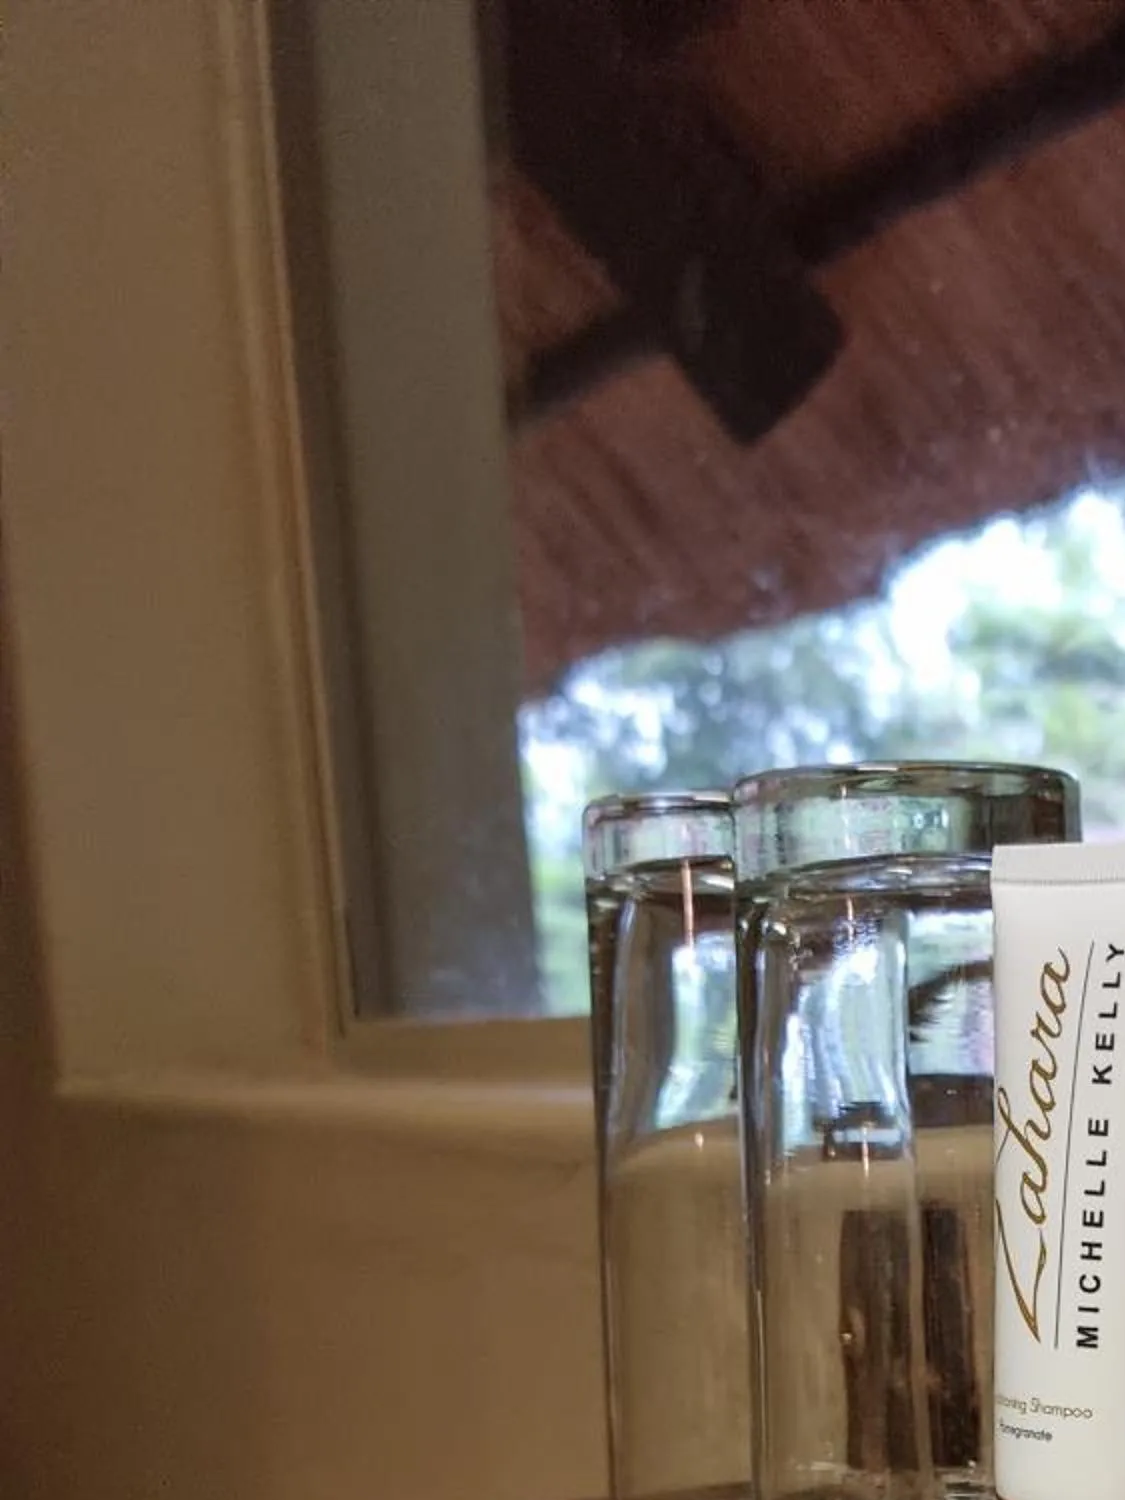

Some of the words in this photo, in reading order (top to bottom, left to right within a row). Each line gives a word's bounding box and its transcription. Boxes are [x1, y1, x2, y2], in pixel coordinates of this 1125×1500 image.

[1091, 942, 1125, 1085] KELLY
[996, 945, 1070, 1345] Zahara
[1076, 1117, 1110, 1349] MICHELLE
[1030, 1397, 1093, 1419] Shampoo
